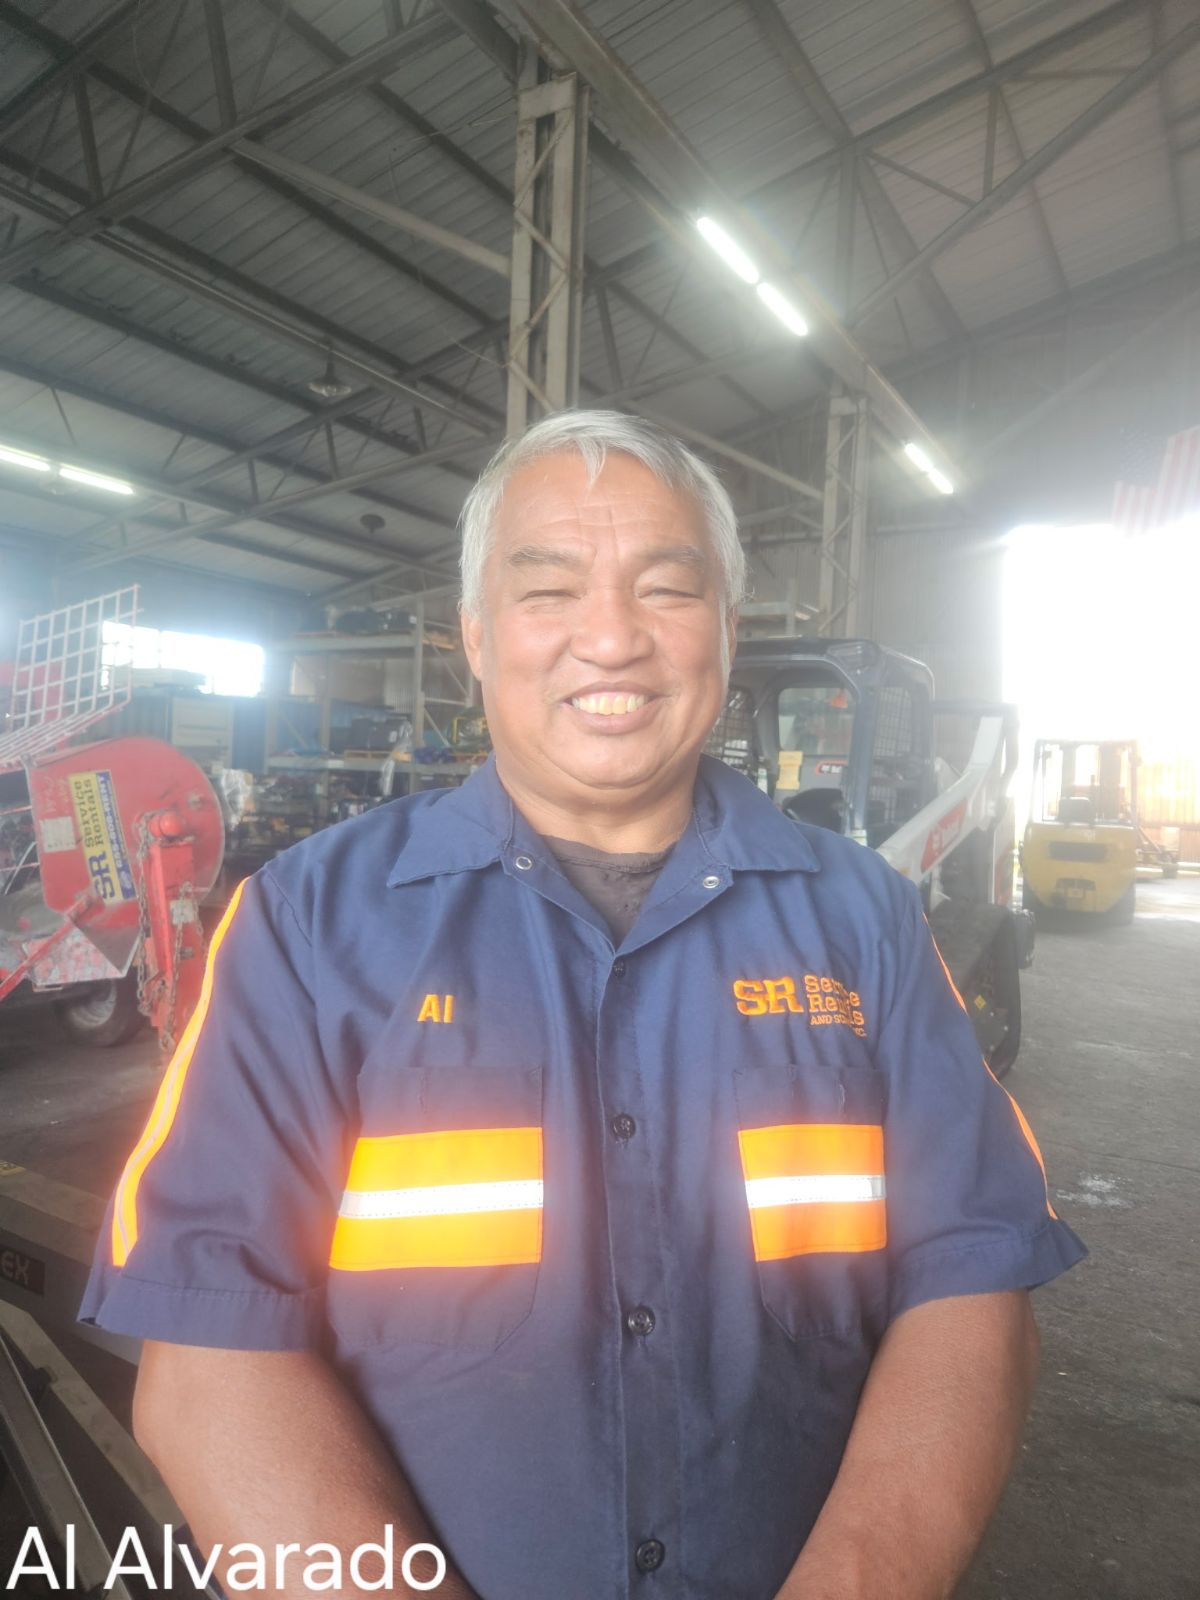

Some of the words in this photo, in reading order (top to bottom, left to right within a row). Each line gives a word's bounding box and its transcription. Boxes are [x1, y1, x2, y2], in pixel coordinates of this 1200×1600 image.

[74, 782, 96, 848] Service
[84, 778, 105, 846] Rentals
[89, 851, 116, 899] SR
[733, 975, 804, 1016] SR
[810, 1014, 833, 1026] AND
